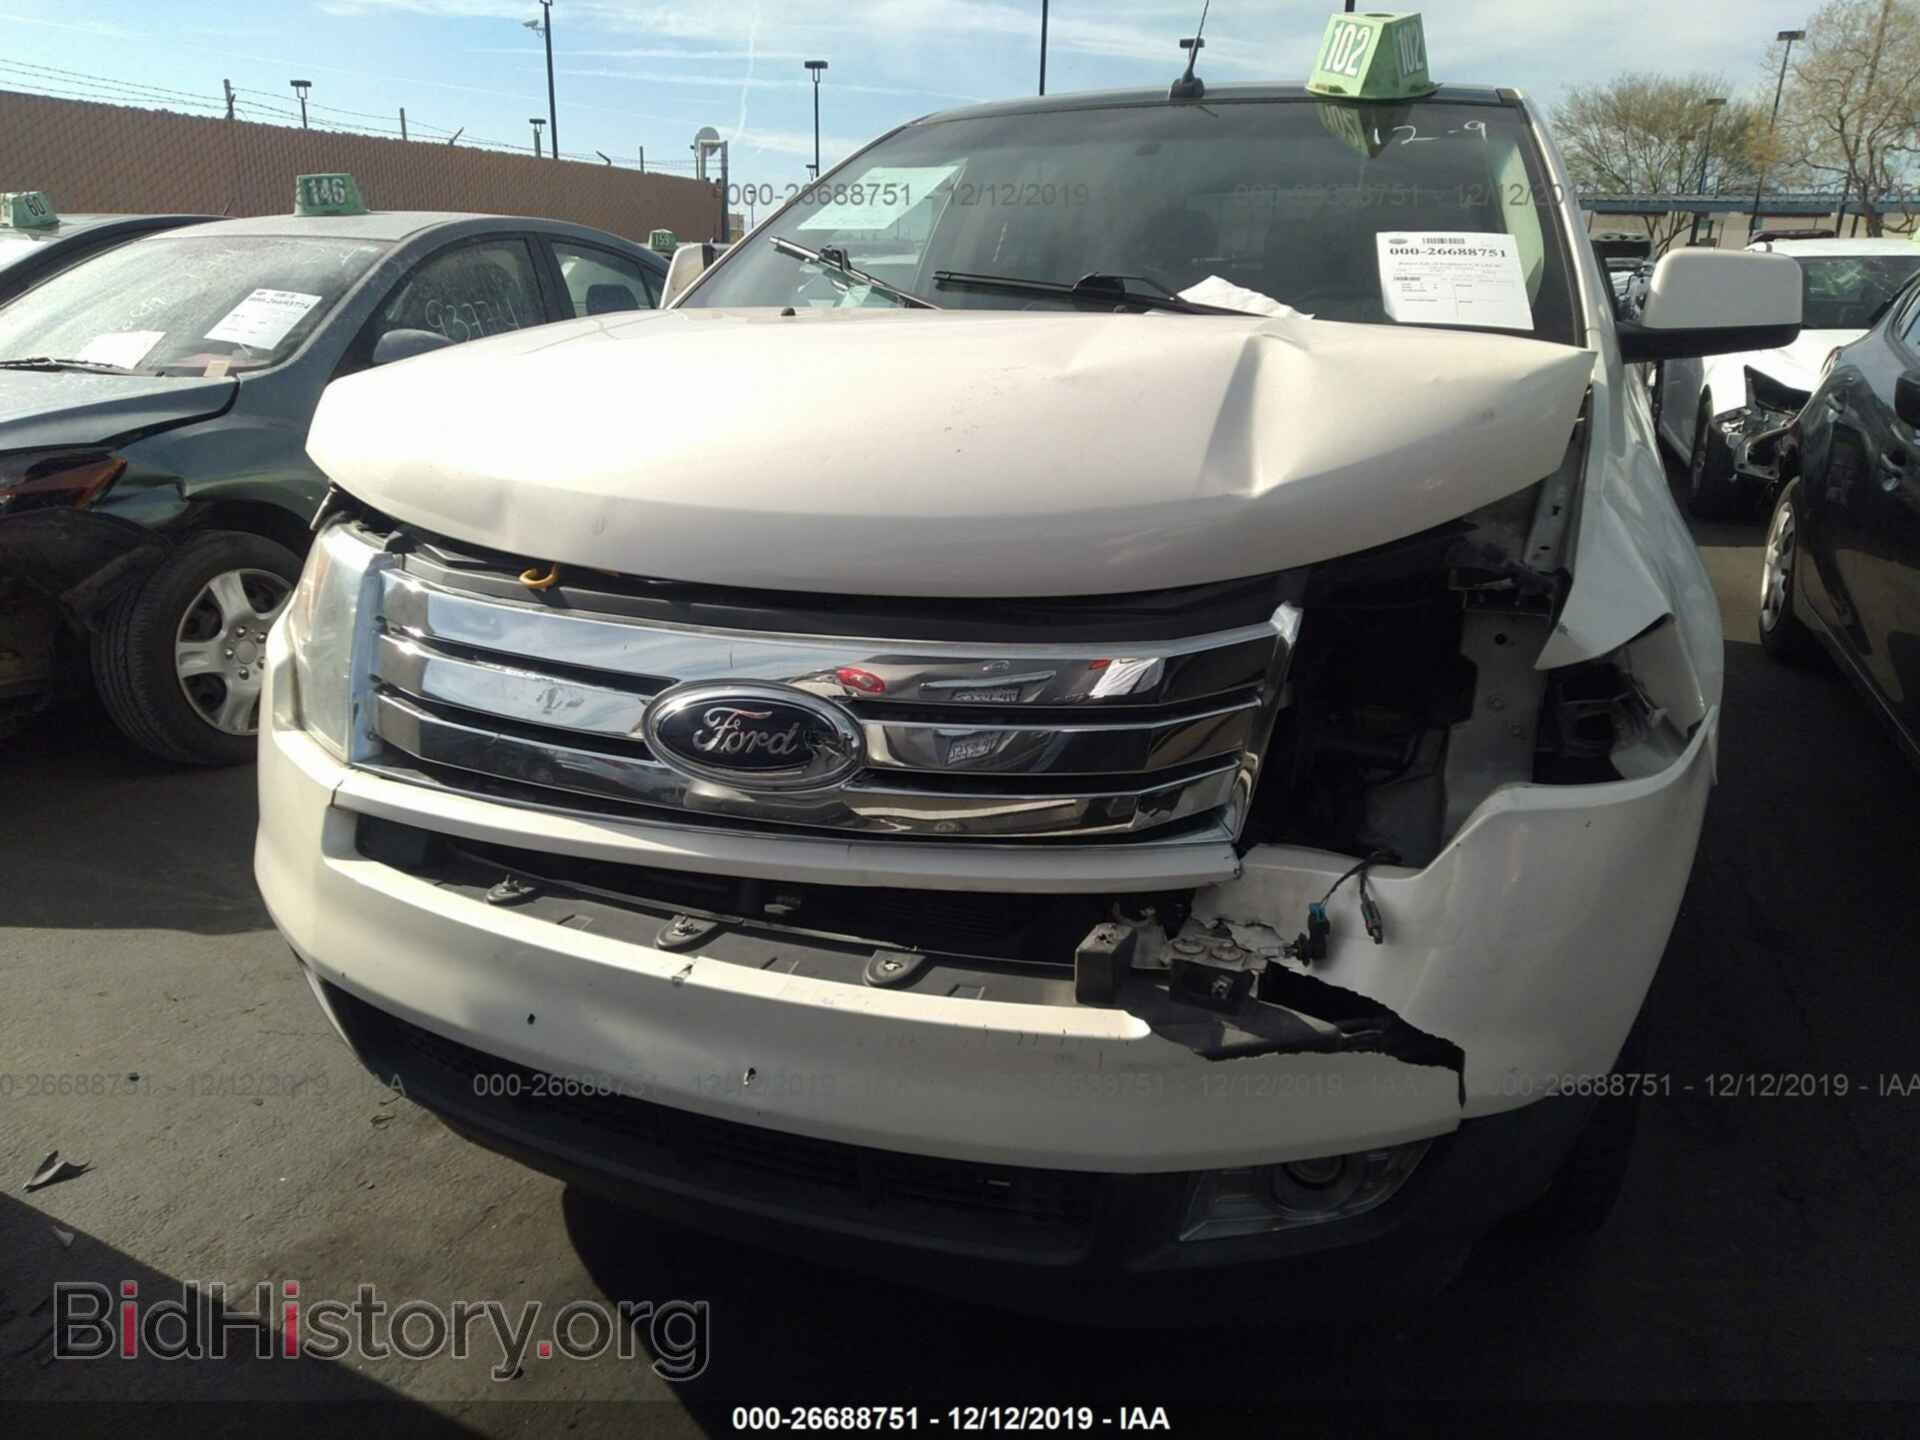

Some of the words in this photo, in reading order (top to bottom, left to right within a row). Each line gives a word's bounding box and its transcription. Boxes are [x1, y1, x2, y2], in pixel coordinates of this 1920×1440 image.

[1323, 22, 1371, 77] 102
[1399, 24, 1424, 77] 102
[308, 177, 345, 205] 146
[1389, 247, 1507, 258] 000-26688751
[692, 706, 800, 755] Ford
